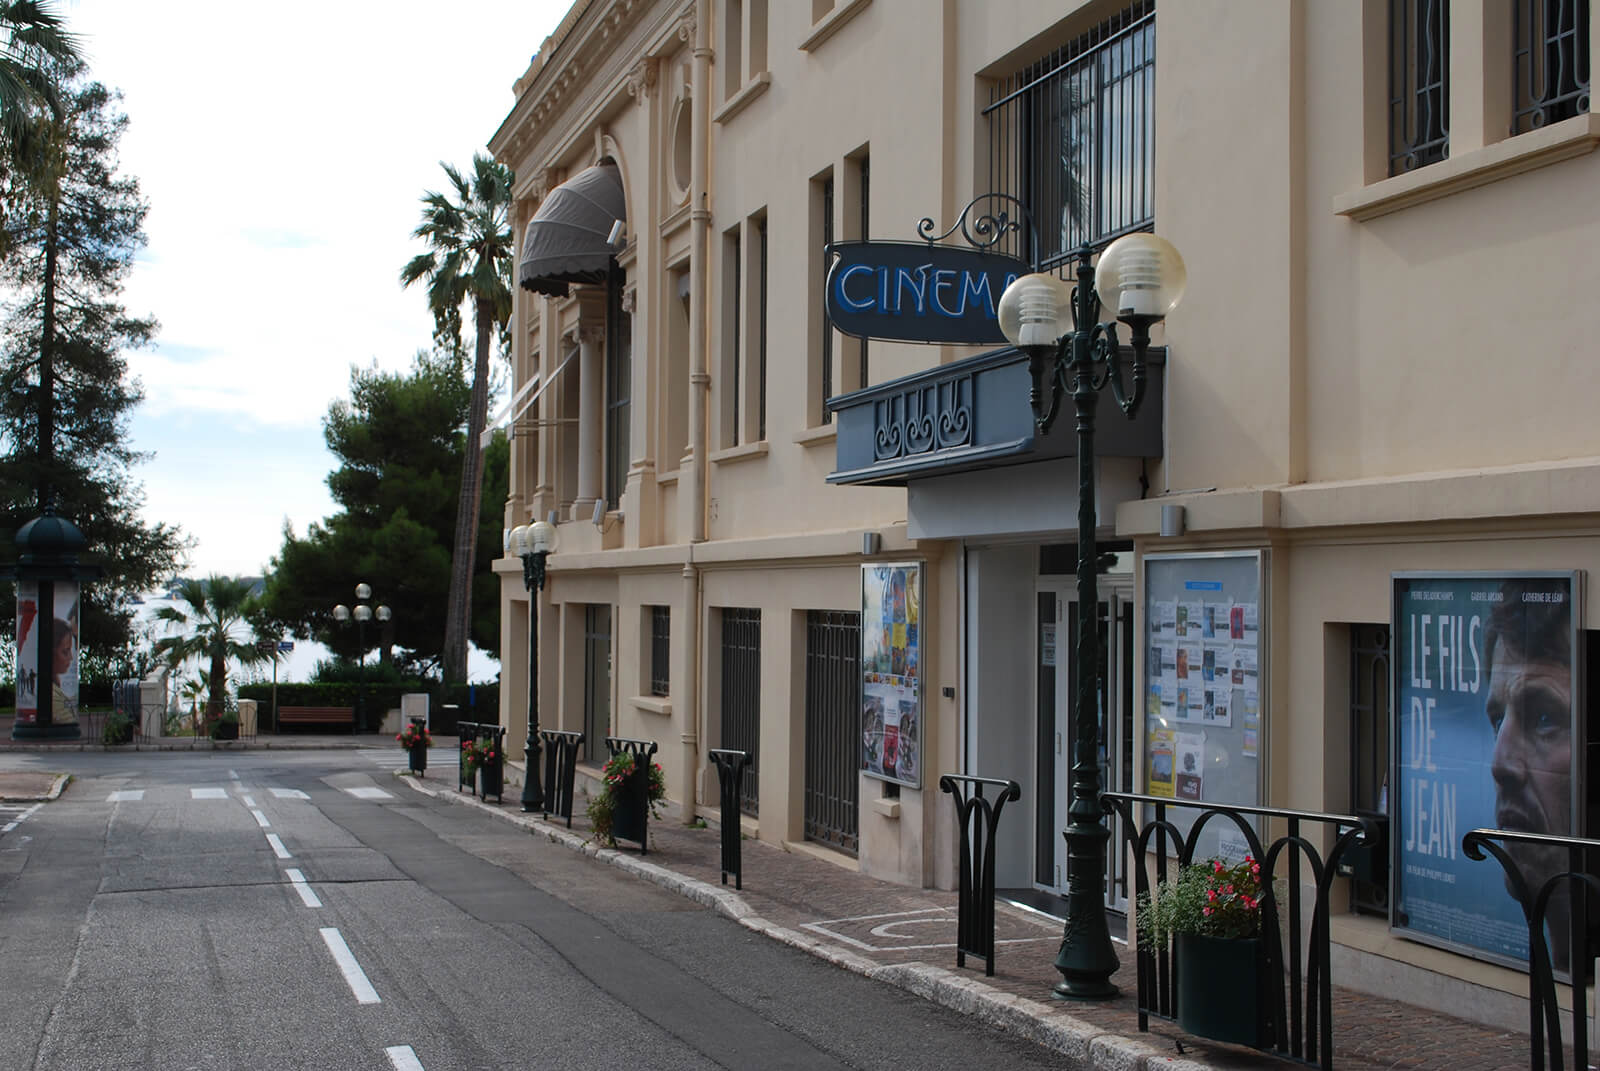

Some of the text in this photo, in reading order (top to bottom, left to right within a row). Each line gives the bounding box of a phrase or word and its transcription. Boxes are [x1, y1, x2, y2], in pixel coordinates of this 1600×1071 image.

[835, 263, 1018, 319] CINÉM
[1411, 614, 1481, 694] LE FILS
[1411, 696, 1436, 773] DE
[1406, 778, 1456, 860] JEAN
